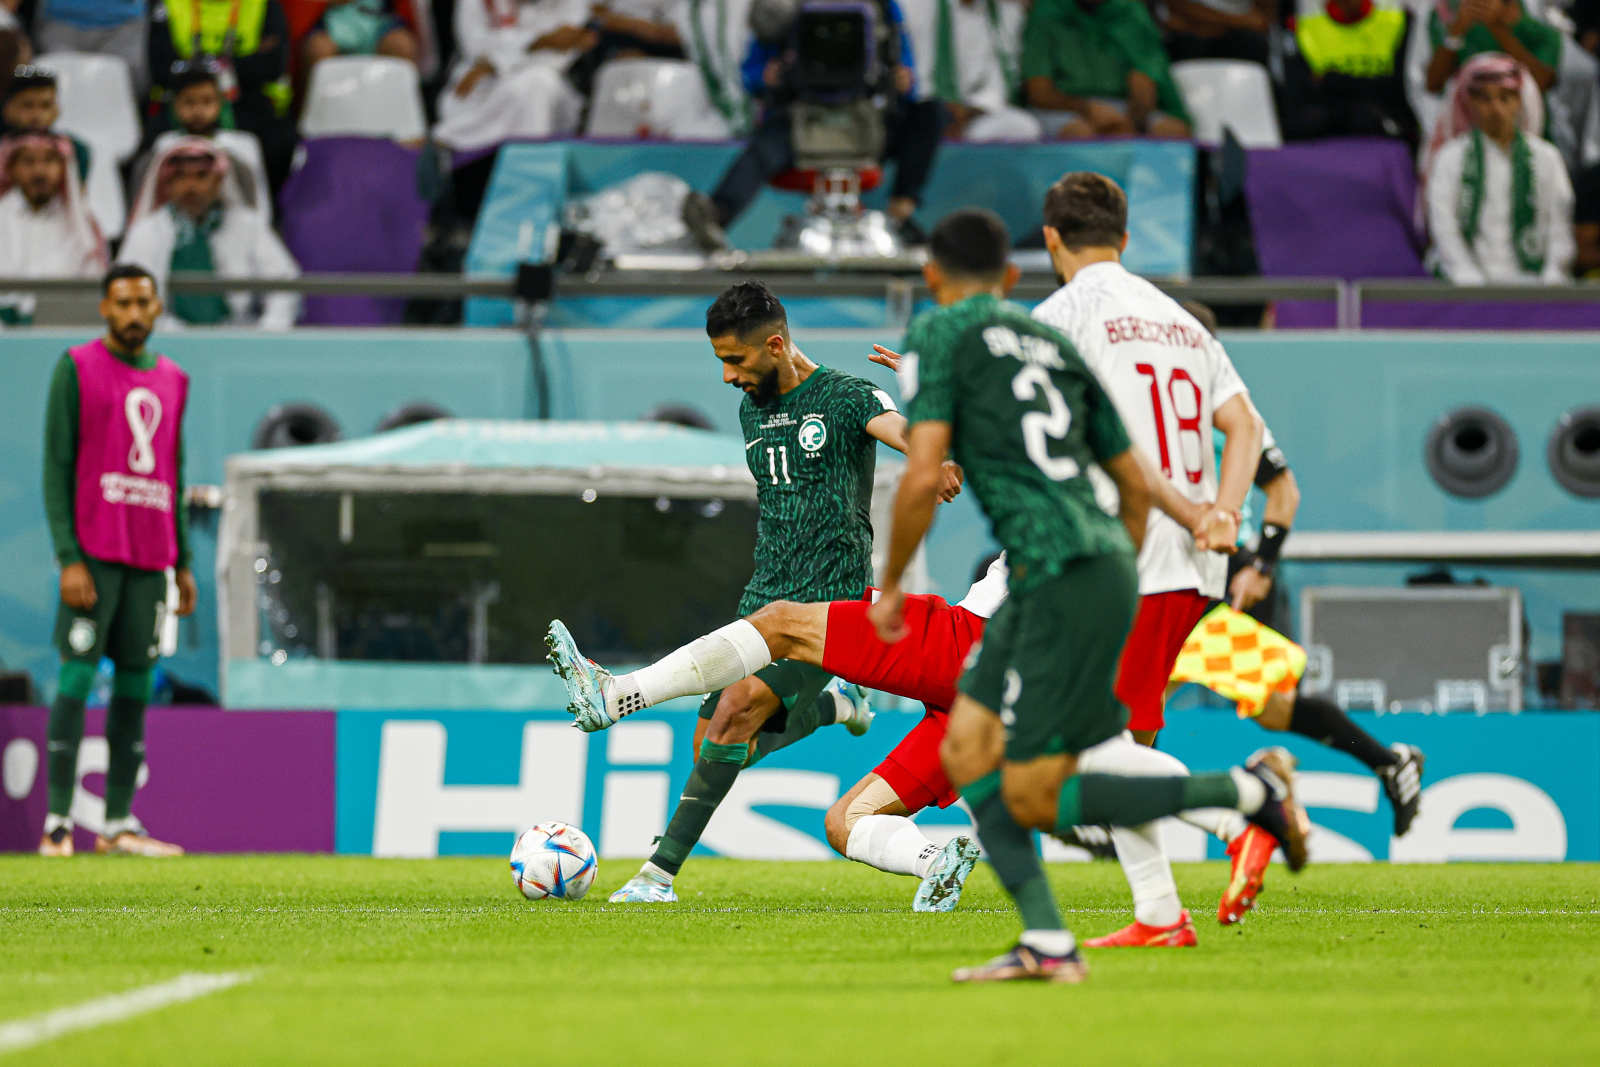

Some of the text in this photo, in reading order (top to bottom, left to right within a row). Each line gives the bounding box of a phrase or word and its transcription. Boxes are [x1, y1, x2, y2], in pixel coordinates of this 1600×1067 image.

[766, 445, 792, 486] 11
[1011, 364, 1080, 482] 2
[1135, 362, 1203, 485] 18
[372, 719, 1568, 863] Hisse
